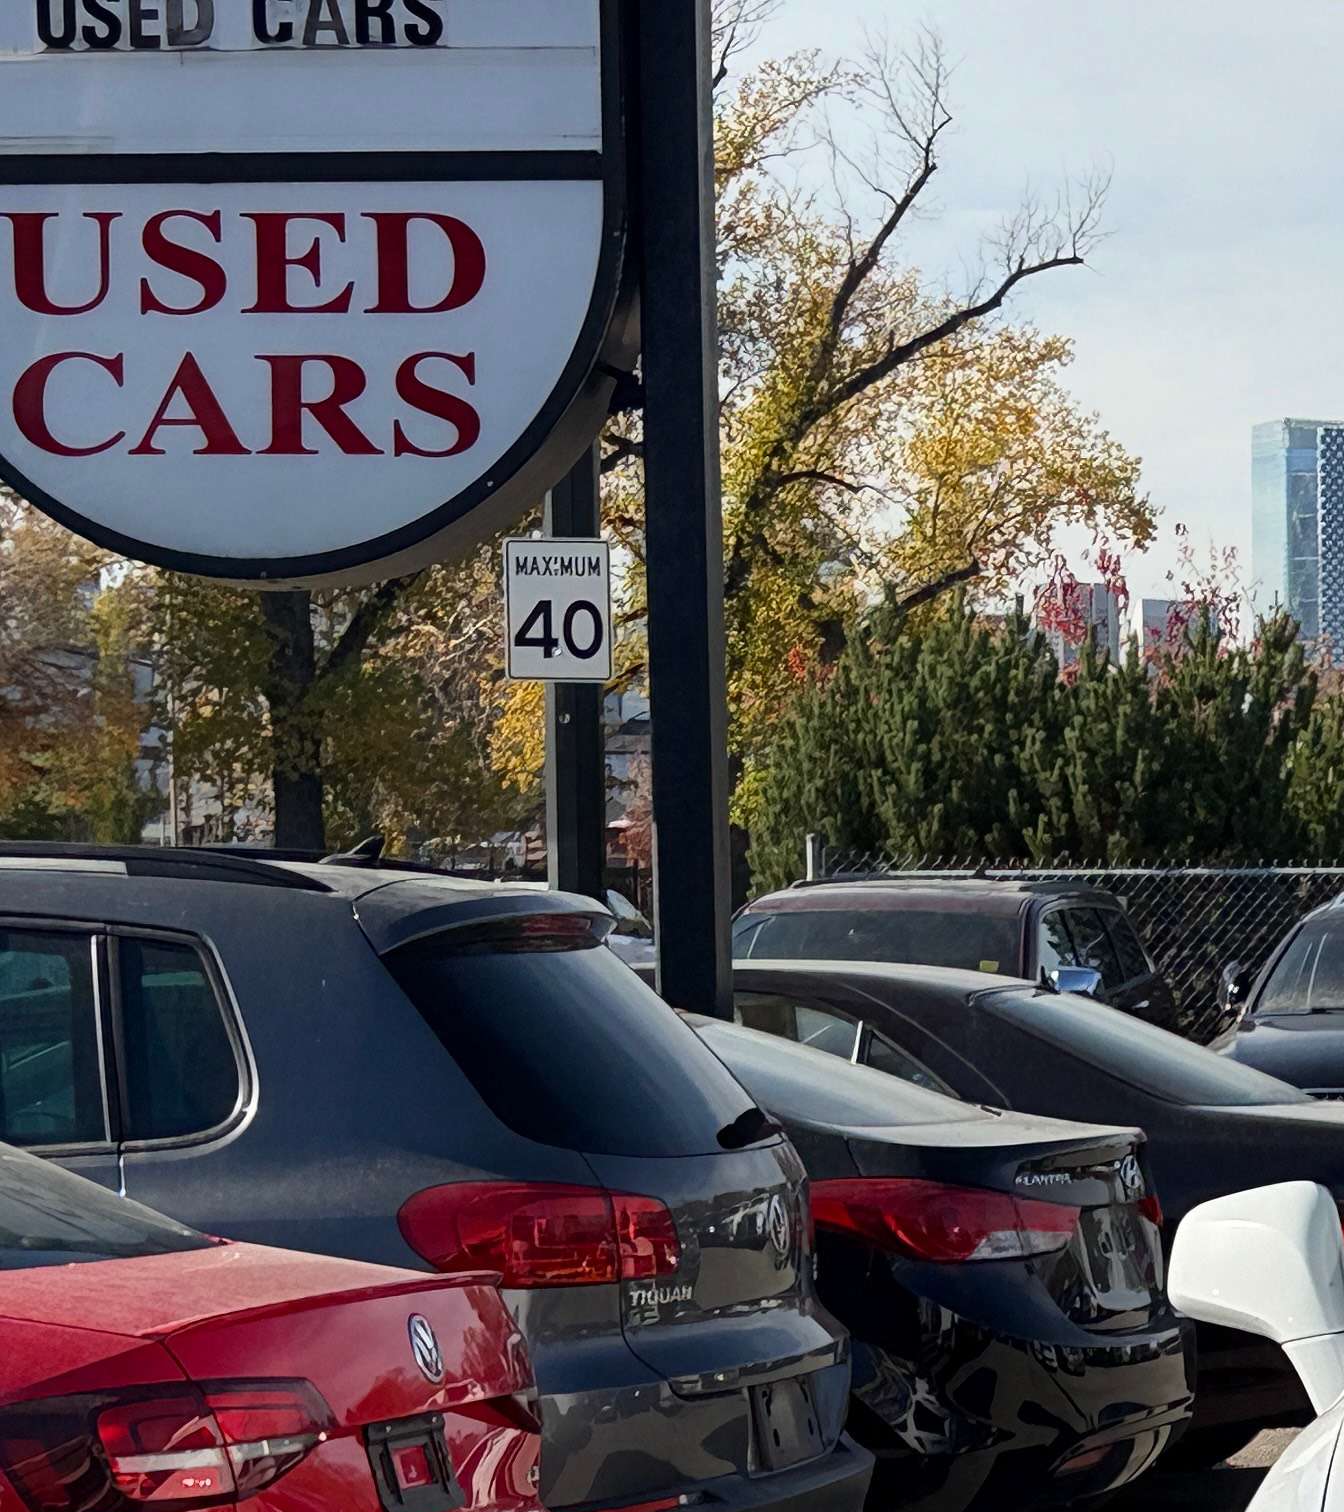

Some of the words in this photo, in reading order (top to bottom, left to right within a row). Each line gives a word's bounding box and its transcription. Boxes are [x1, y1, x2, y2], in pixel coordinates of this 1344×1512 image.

[0, 209, 487, 316] USED
[12, 351, 482, 458] CARS
[515, 556, 601, 577] MAXIMUM
[514, 599, 604, 660] 40
